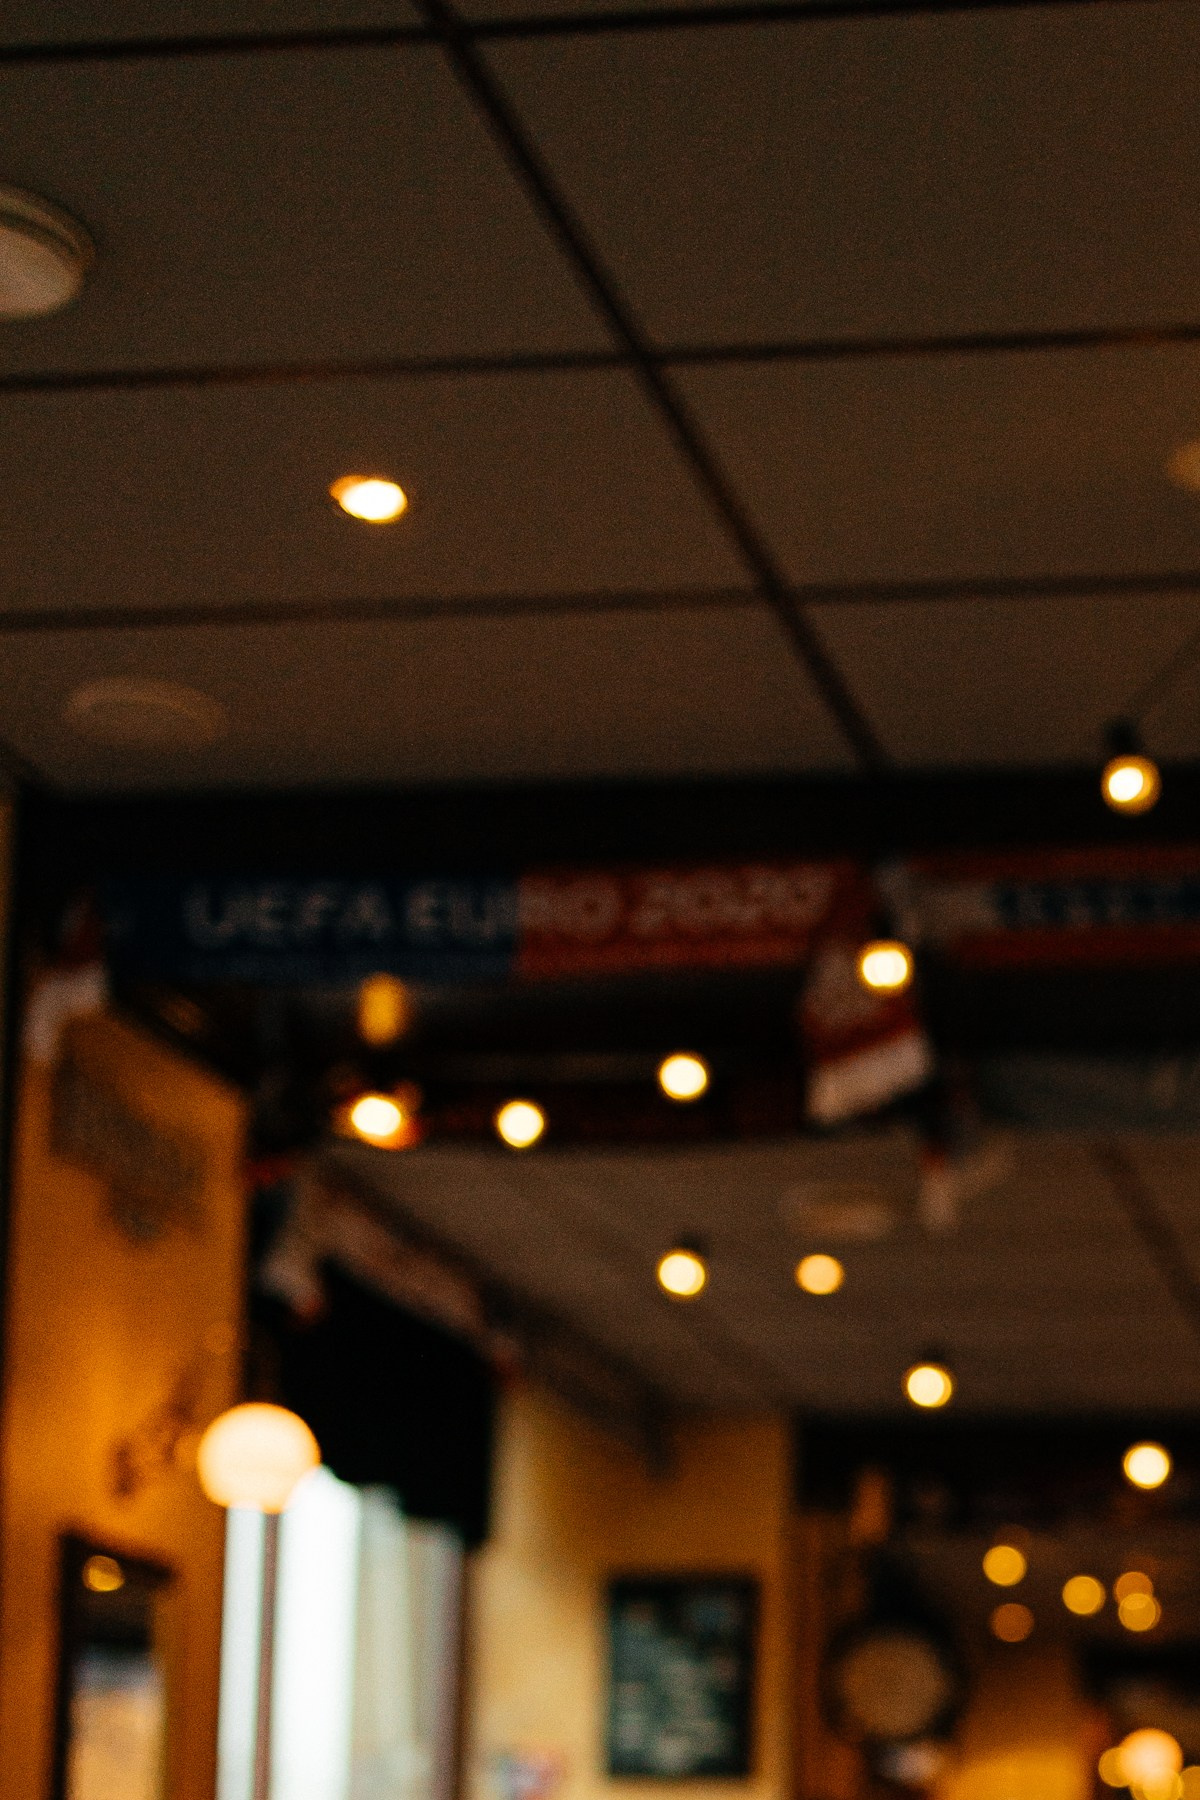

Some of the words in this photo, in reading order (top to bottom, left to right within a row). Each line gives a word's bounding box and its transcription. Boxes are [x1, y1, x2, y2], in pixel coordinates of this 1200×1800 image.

[183, 878, 391, 946] UEFA
[403, 871, 621, 942] EURO
[629, 866, 835, 936] 2020
